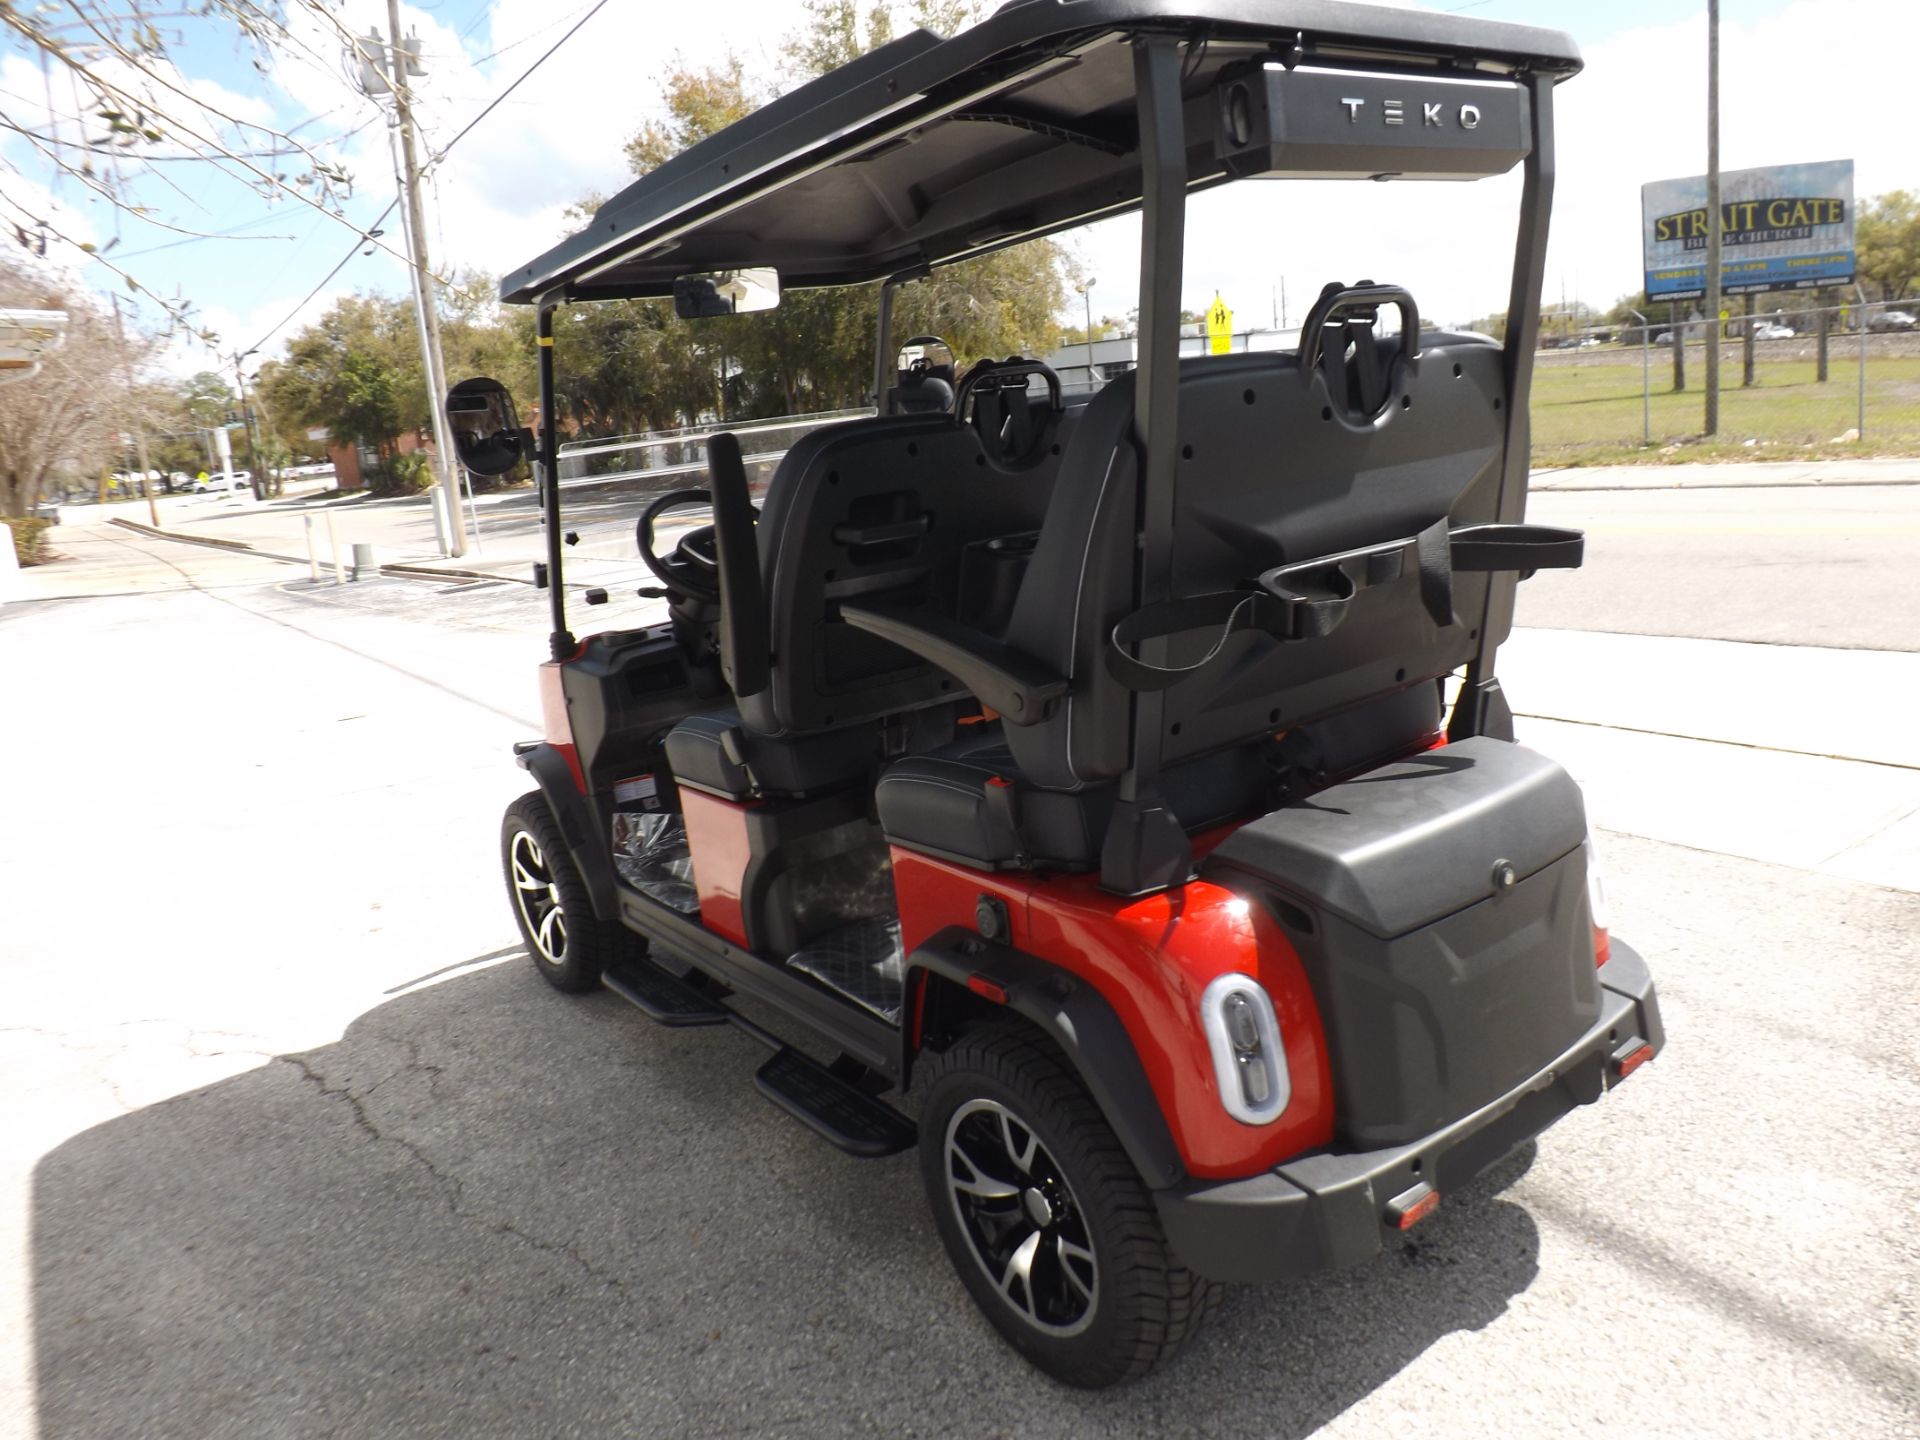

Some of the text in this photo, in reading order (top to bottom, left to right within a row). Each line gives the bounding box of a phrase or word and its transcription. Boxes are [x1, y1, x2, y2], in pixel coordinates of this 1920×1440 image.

[1341, 98, 1481, 129] TEKO
[1767, 200, 1842, 228] GATE
[1738, 226, 1810, 243] CHURCH
